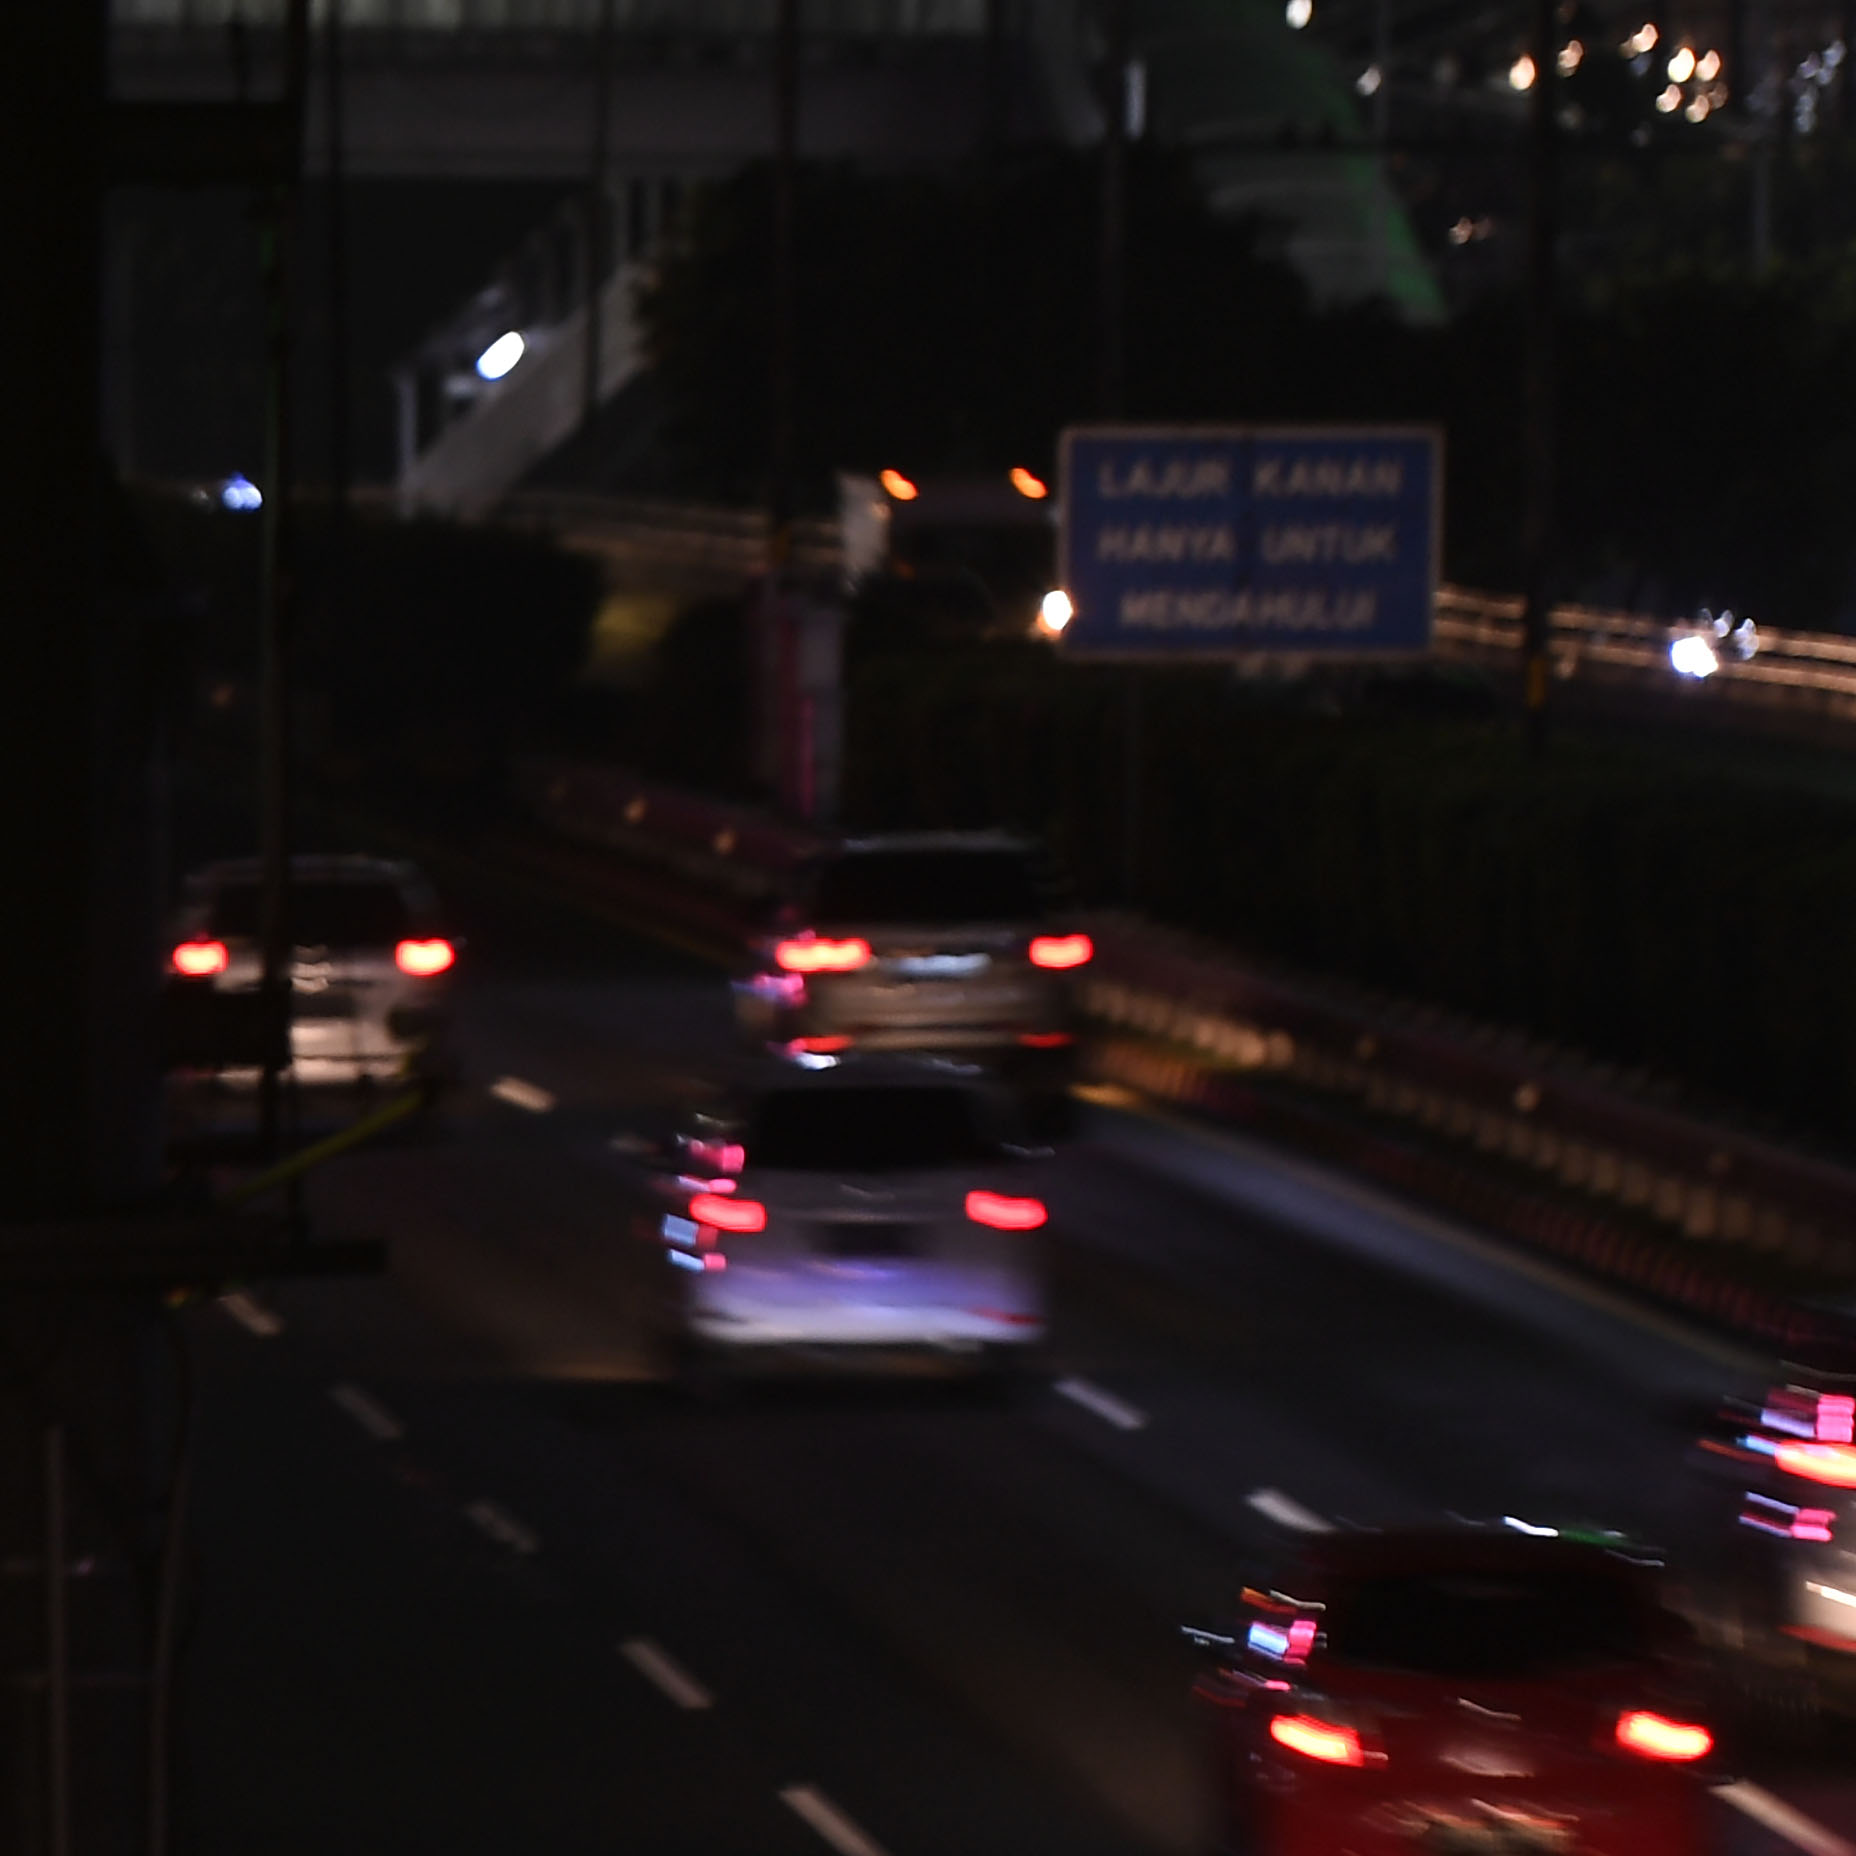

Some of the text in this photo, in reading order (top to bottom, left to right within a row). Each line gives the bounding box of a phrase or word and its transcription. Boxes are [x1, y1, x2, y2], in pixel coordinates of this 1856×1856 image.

[1097, 456, 1404, 499] LAJUR KANAN
[1096, 522, 1397, 565] HANYA UNTUK
